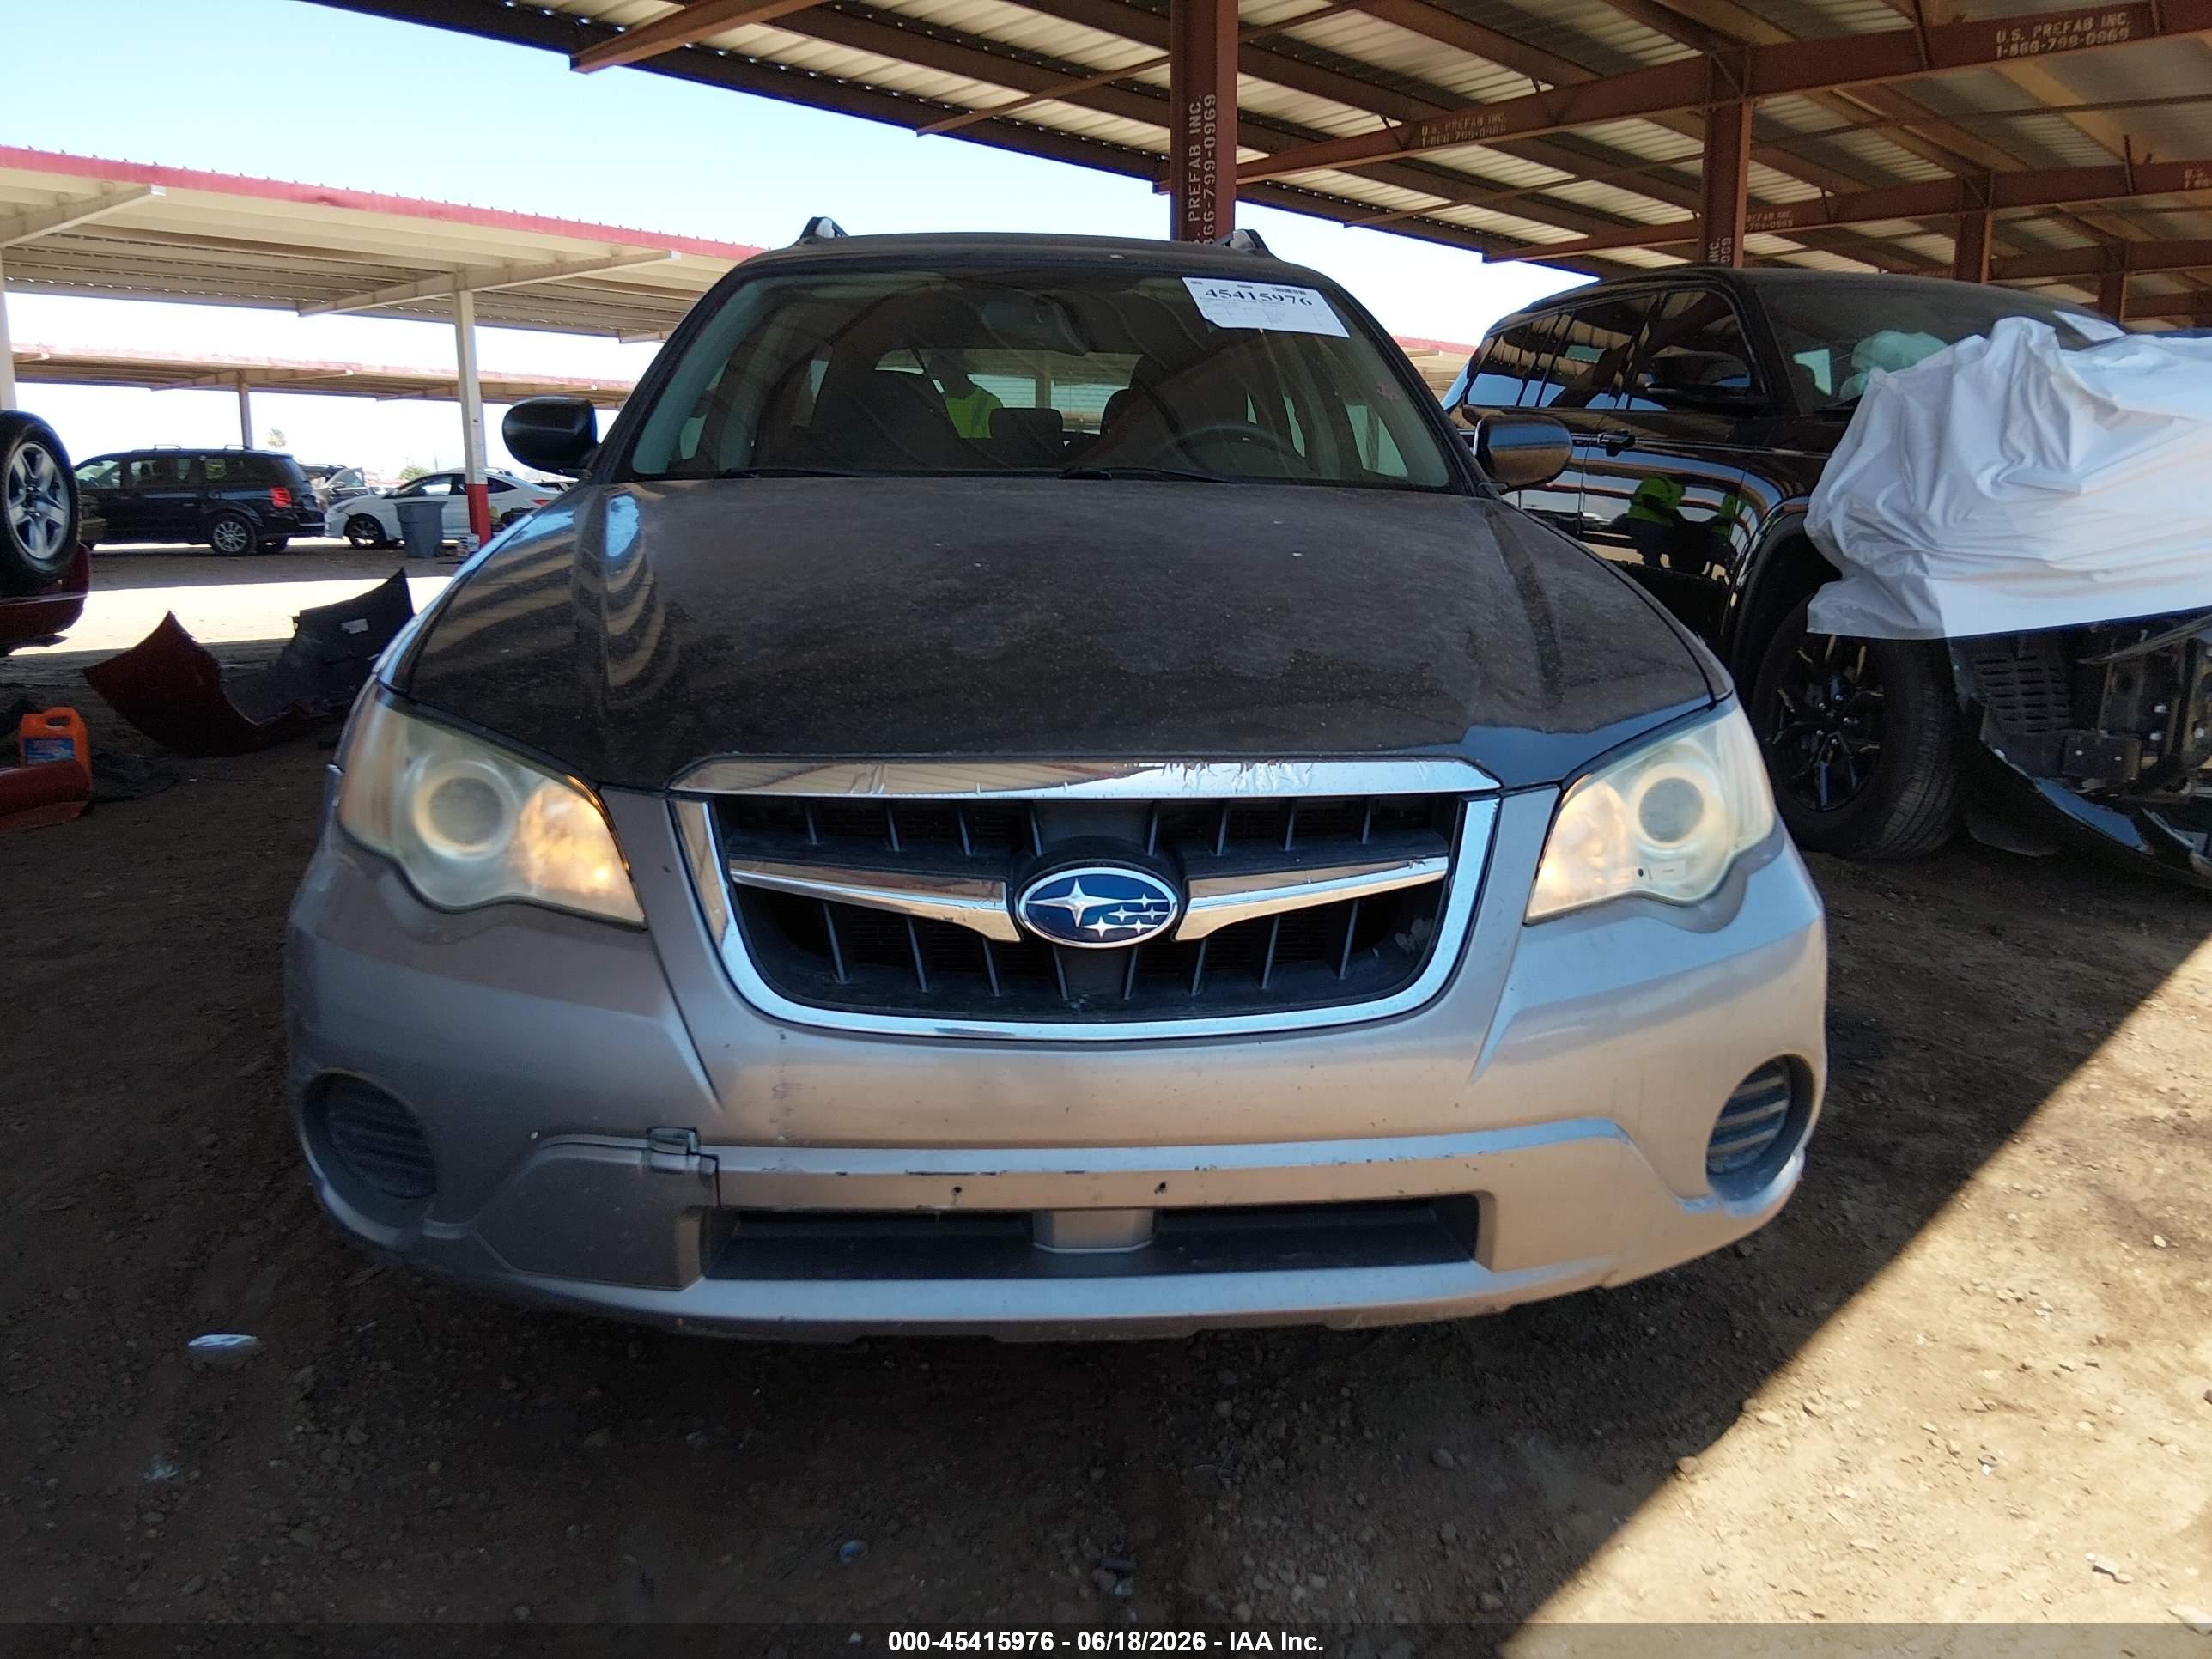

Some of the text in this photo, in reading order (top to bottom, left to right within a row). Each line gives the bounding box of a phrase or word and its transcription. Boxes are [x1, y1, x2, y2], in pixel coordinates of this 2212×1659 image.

[2033, 16, 2094, 39] PREFAB
[1189, 96, 1202, 134] INC.
[1188, 144, 1201, 222] PREFAB
[1206, 288, 1313, 307] 45415976
